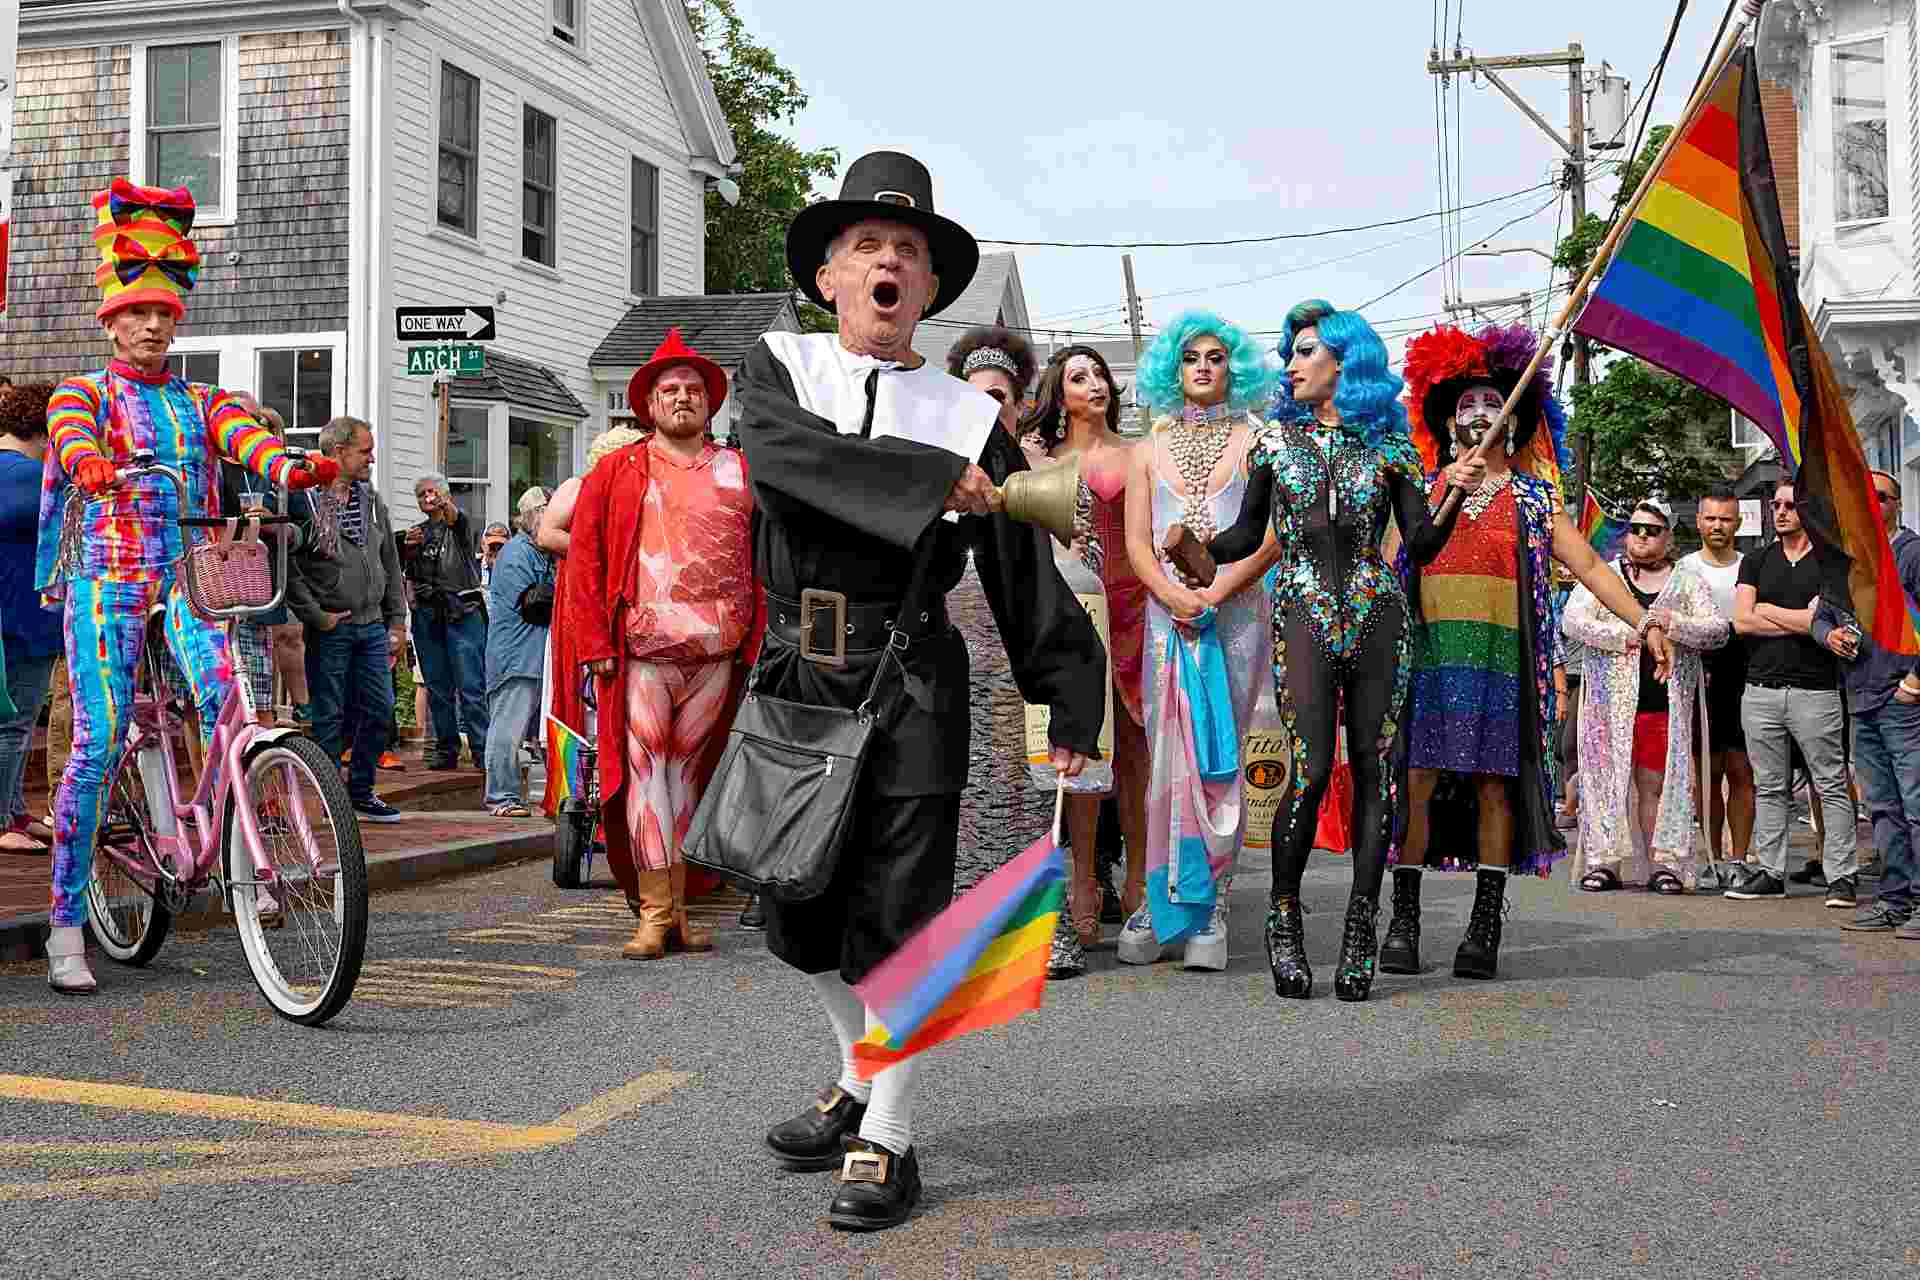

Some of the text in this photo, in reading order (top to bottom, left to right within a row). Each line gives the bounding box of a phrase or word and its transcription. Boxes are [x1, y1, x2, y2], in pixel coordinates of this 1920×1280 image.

[404, 317, 463, 330] ONE WAY
[411, 349, 480, 371] ARCH ST
